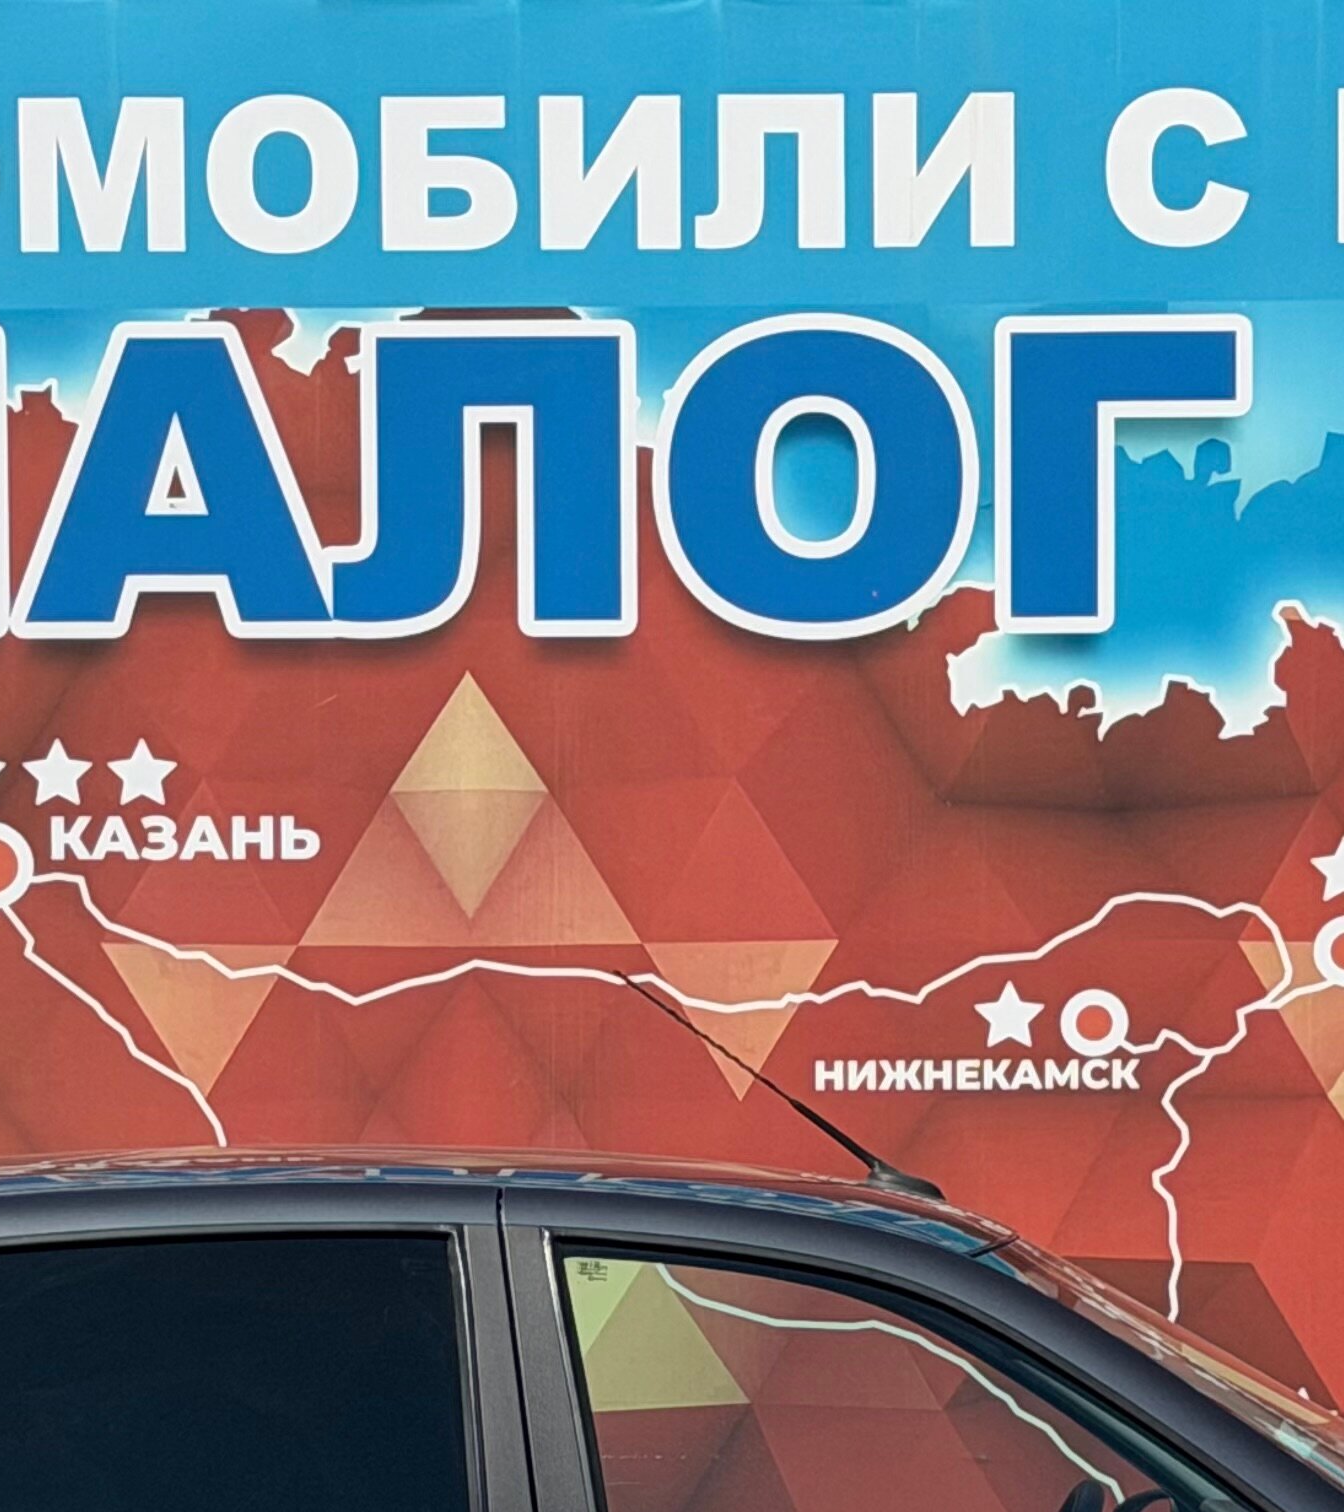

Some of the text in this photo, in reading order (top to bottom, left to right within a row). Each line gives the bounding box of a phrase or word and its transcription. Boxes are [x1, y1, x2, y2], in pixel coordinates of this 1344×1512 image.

[1105, 87, 1251, 248] С
[50, 815, 321, 861] КАЗАНЬ
[814, 1058, 1140, 1091] НИЖНЕКАМСК
